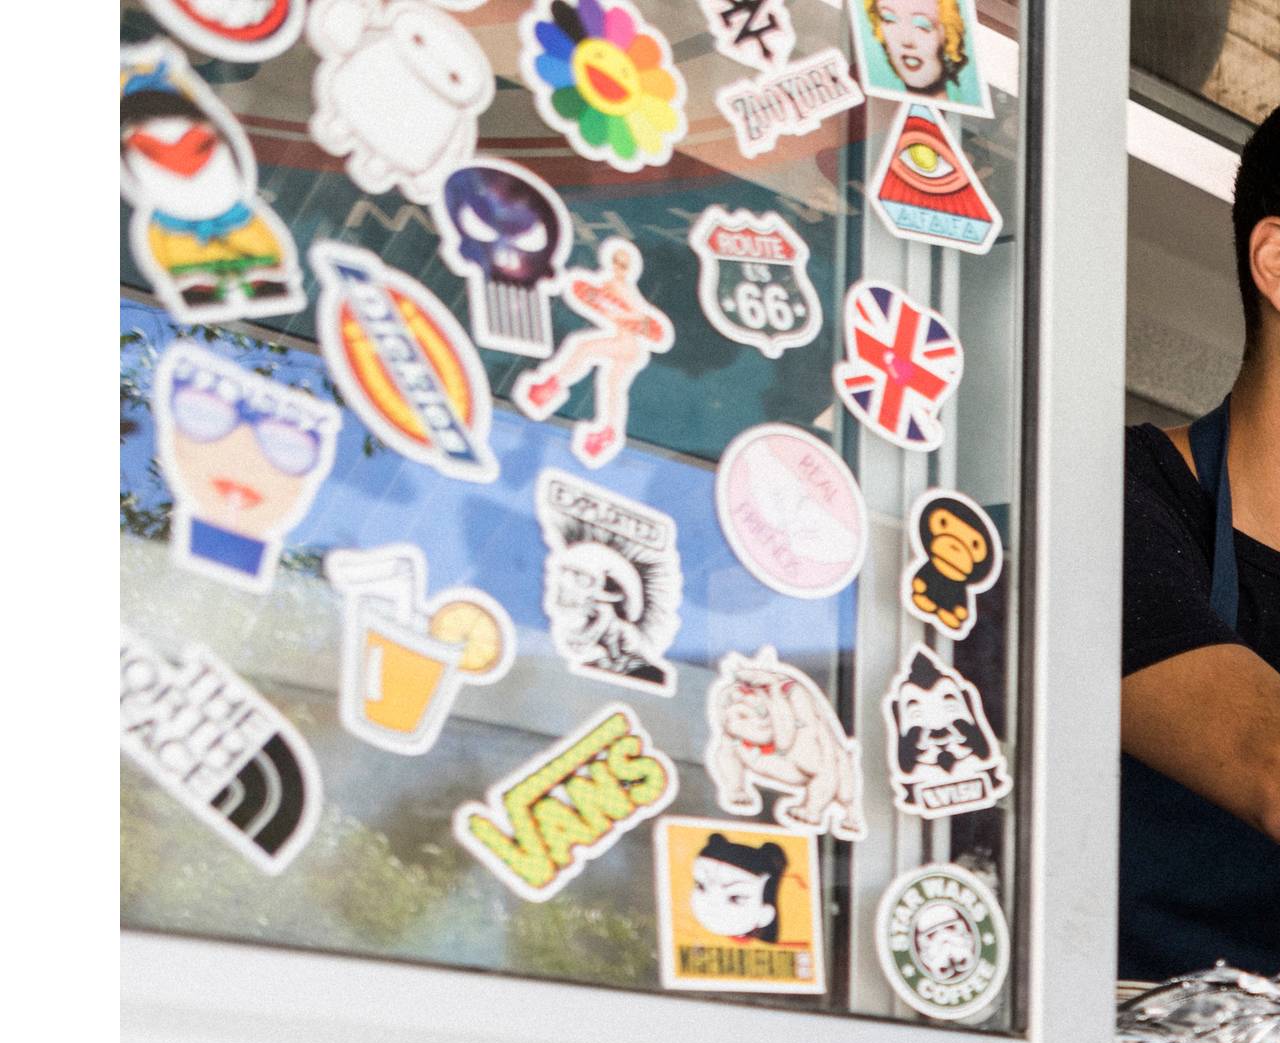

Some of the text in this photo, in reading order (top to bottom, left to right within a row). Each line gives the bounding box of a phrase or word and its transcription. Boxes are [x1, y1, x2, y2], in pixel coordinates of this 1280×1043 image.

[717, 233, 786, 259] ROUTE
[735, 282, 795, 331] 66
[121, 643, 246, 770] ORTH
[469, 712, 668, 889] VANS
[890, 877, 988, 952] STAR WARS
[916, 958, 996, 1006] COFFEE
